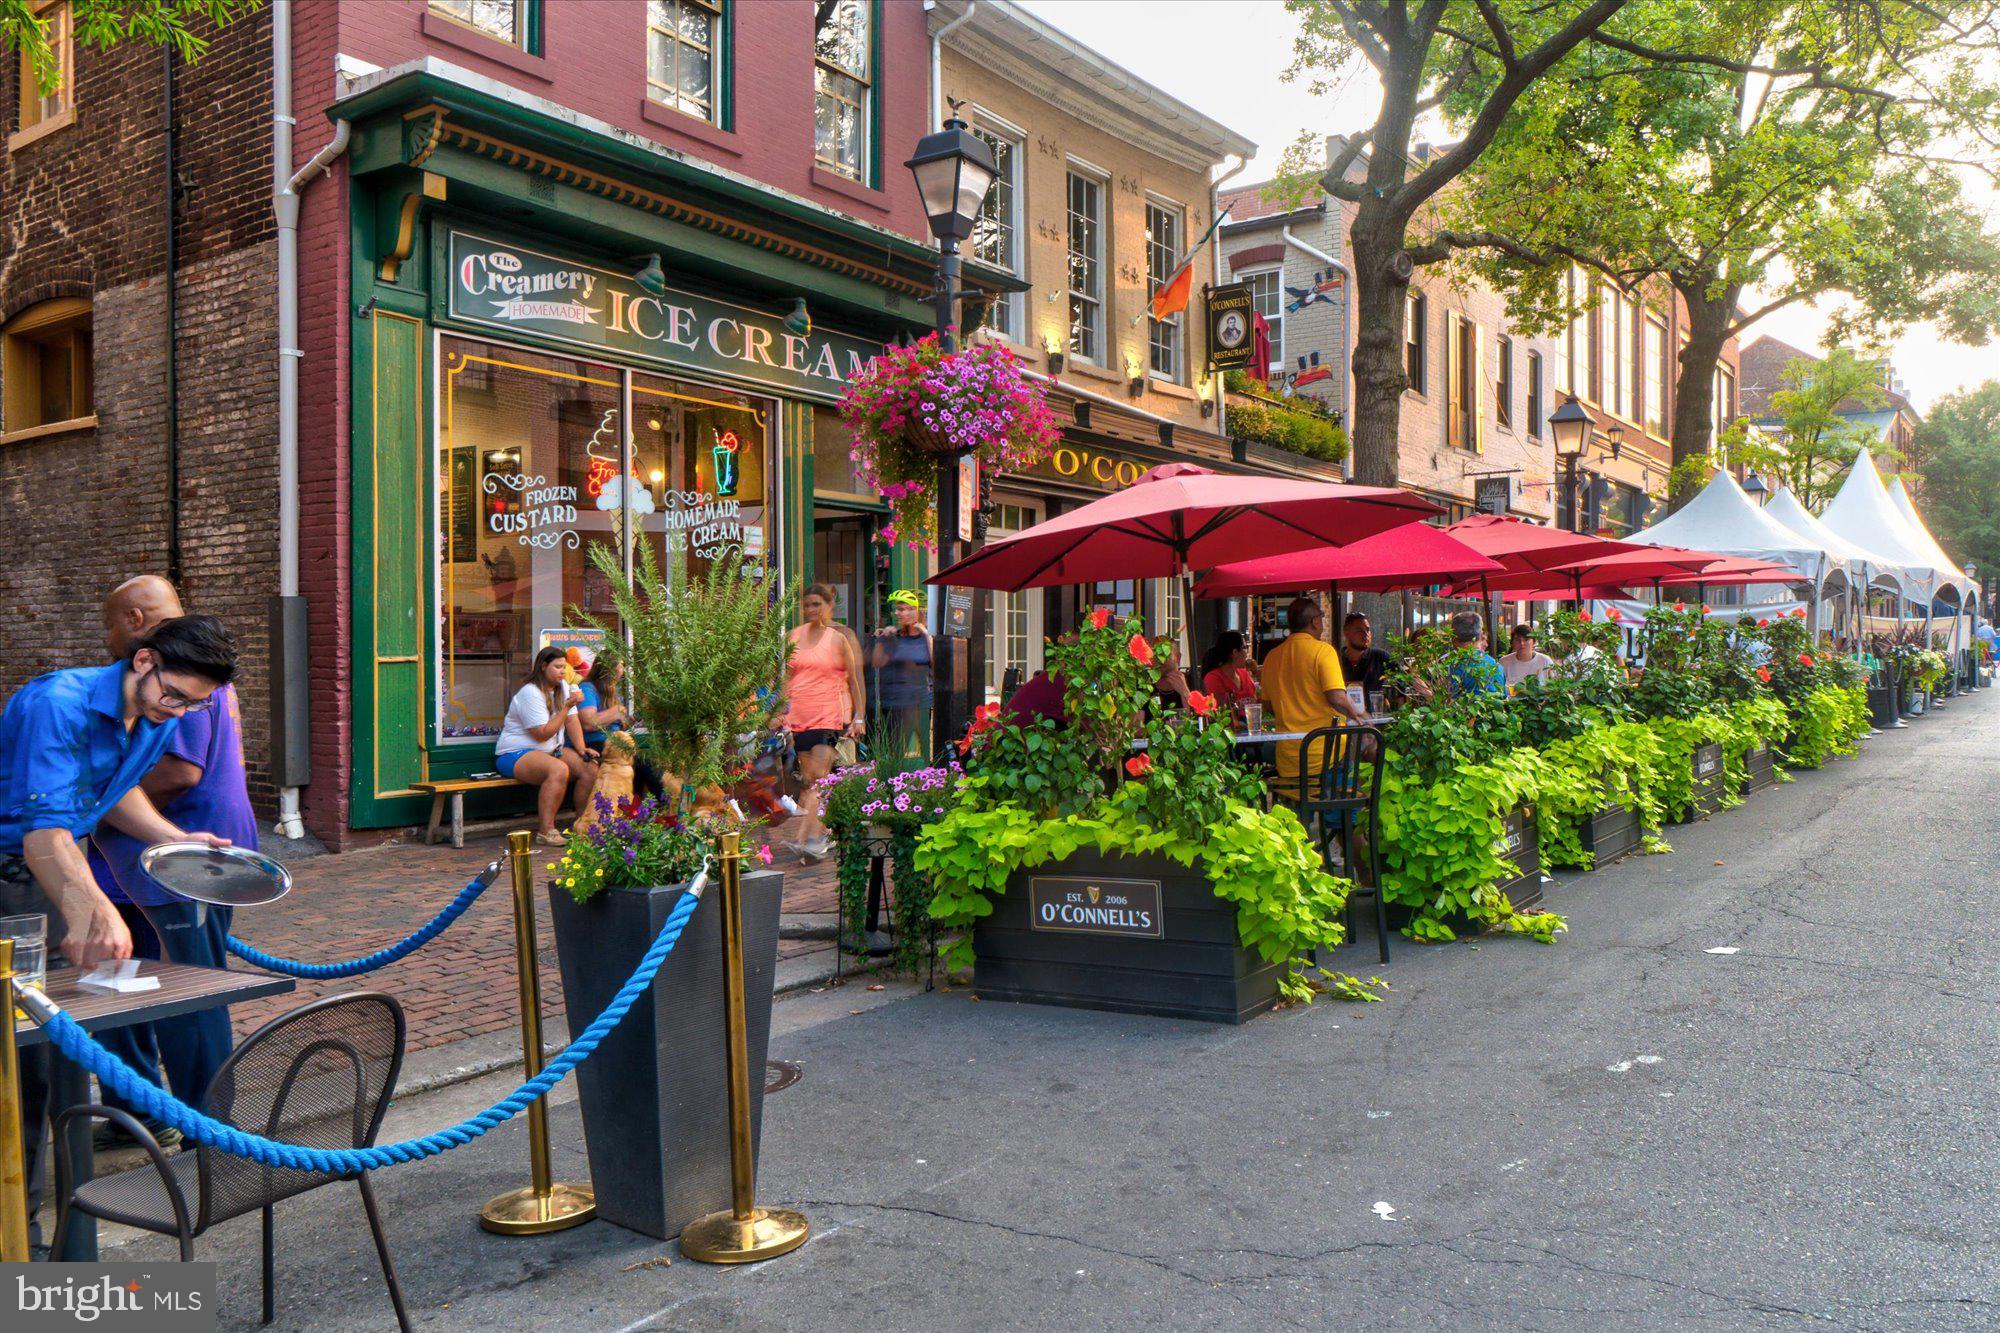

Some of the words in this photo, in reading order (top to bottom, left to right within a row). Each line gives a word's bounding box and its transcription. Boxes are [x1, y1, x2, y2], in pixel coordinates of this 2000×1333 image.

[493, 256, 519, 268] The
[461, 254, 597, 299] Creamery
[512, 304, 582, 320] HOMEMADE
[1212, 296, 1250, 311] O'CONNELL'S
[605, 289, 699, 351] ICE
[708, 318, 878, 384] CREAM
[1213, 347, 1250, 360] RESTAURANT
[1053, 449, 1150, 486] O'CO
[525, 486, 577, 507] FROZEN
[490, 505, 577, 533] CUSTARD
[665, 500, 741, 529] HOMEMADE
[691, 522, 742, 547] CREAM
[1066, 893, 1084, 903] EST.
[1105, 895, 1128, 905] 2006
[1041, 903, 1151, 928] O'CONNELL'S
